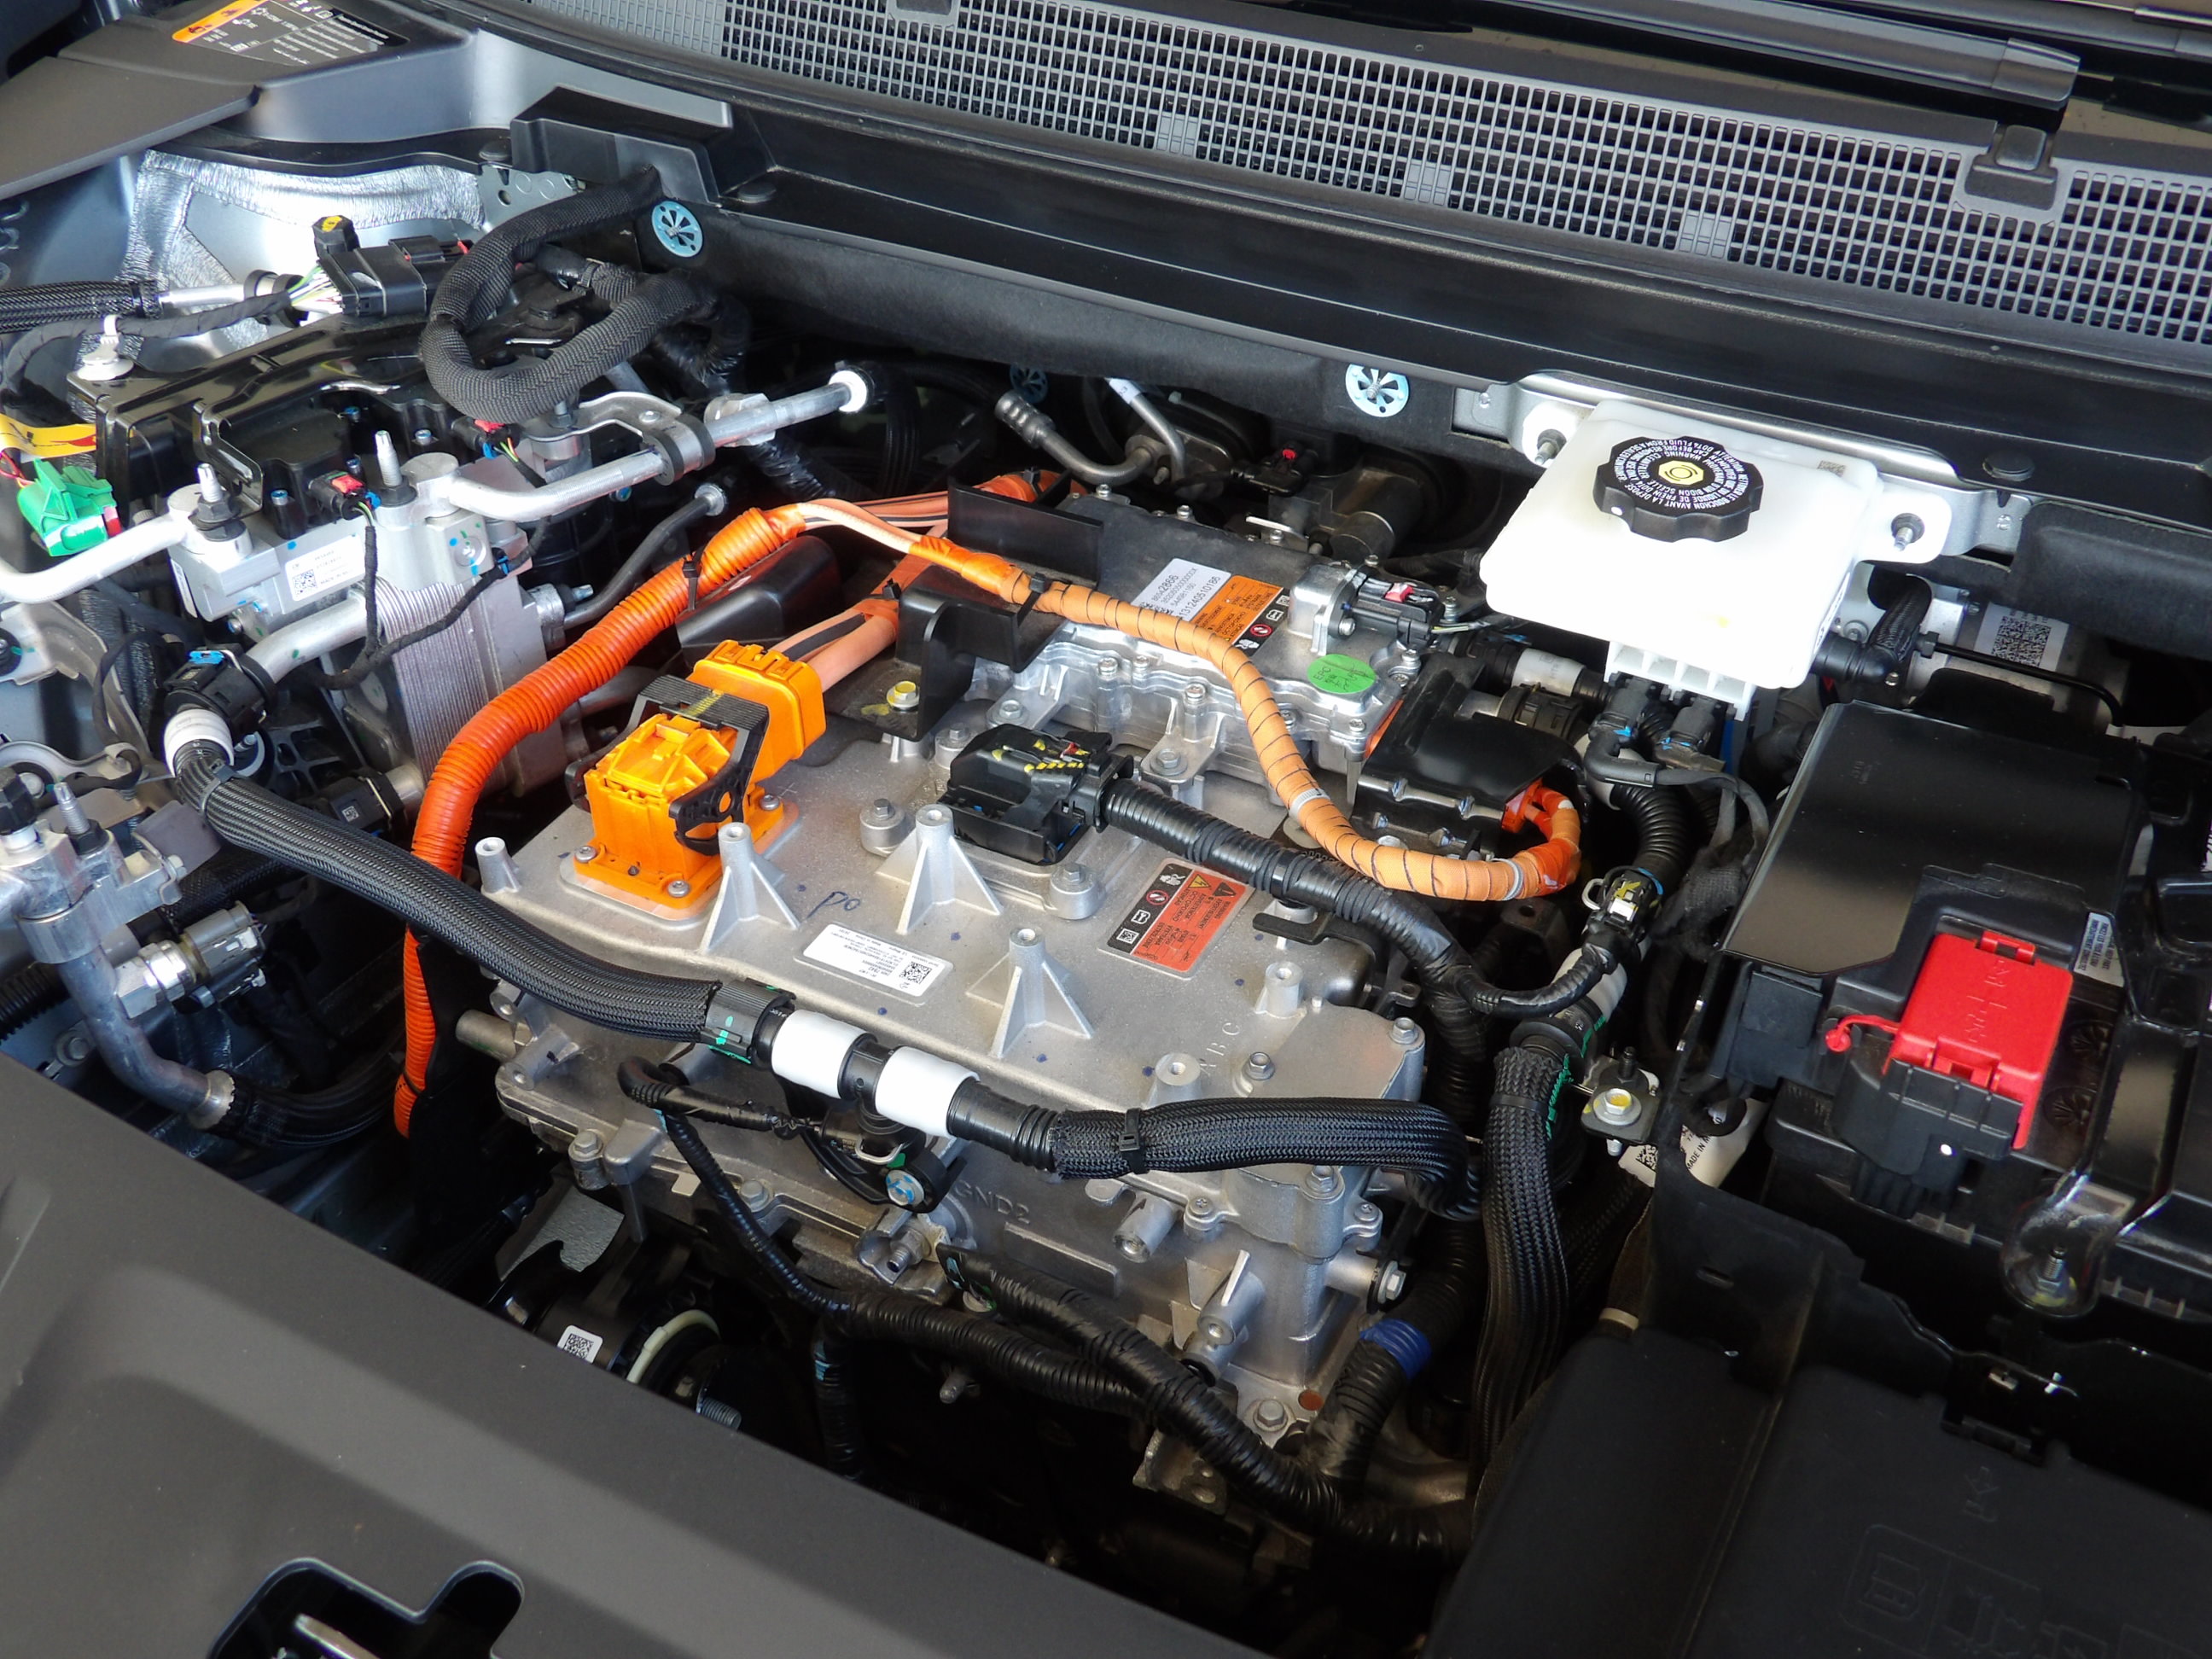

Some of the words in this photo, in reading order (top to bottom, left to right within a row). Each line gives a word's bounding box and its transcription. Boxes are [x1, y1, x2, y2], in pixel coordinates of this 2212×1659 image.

[1693, 442, 1714, 452] DOT4
[1635, 480, 1654, 492] DOT4
[1652, 490, 1677, 501] FREIN
[1652, 496, 1664, 504] LA
[1692, 492, 1721, 502] LIQUIDE
[1726, 492, 1739, 501] LE
[1664, 500, 1691, 509] AVANT
[1693, 497, 1731, 509] BOUCHON
[1206, 1042, 1227, 1057] B
[1221, 1022, 1241, 1036] C
[1686, 1153, 1701, 1170] MADE
[1697, 1144, 1706, 1152] IN
[954, 1179, 1031, 1225] GND2
